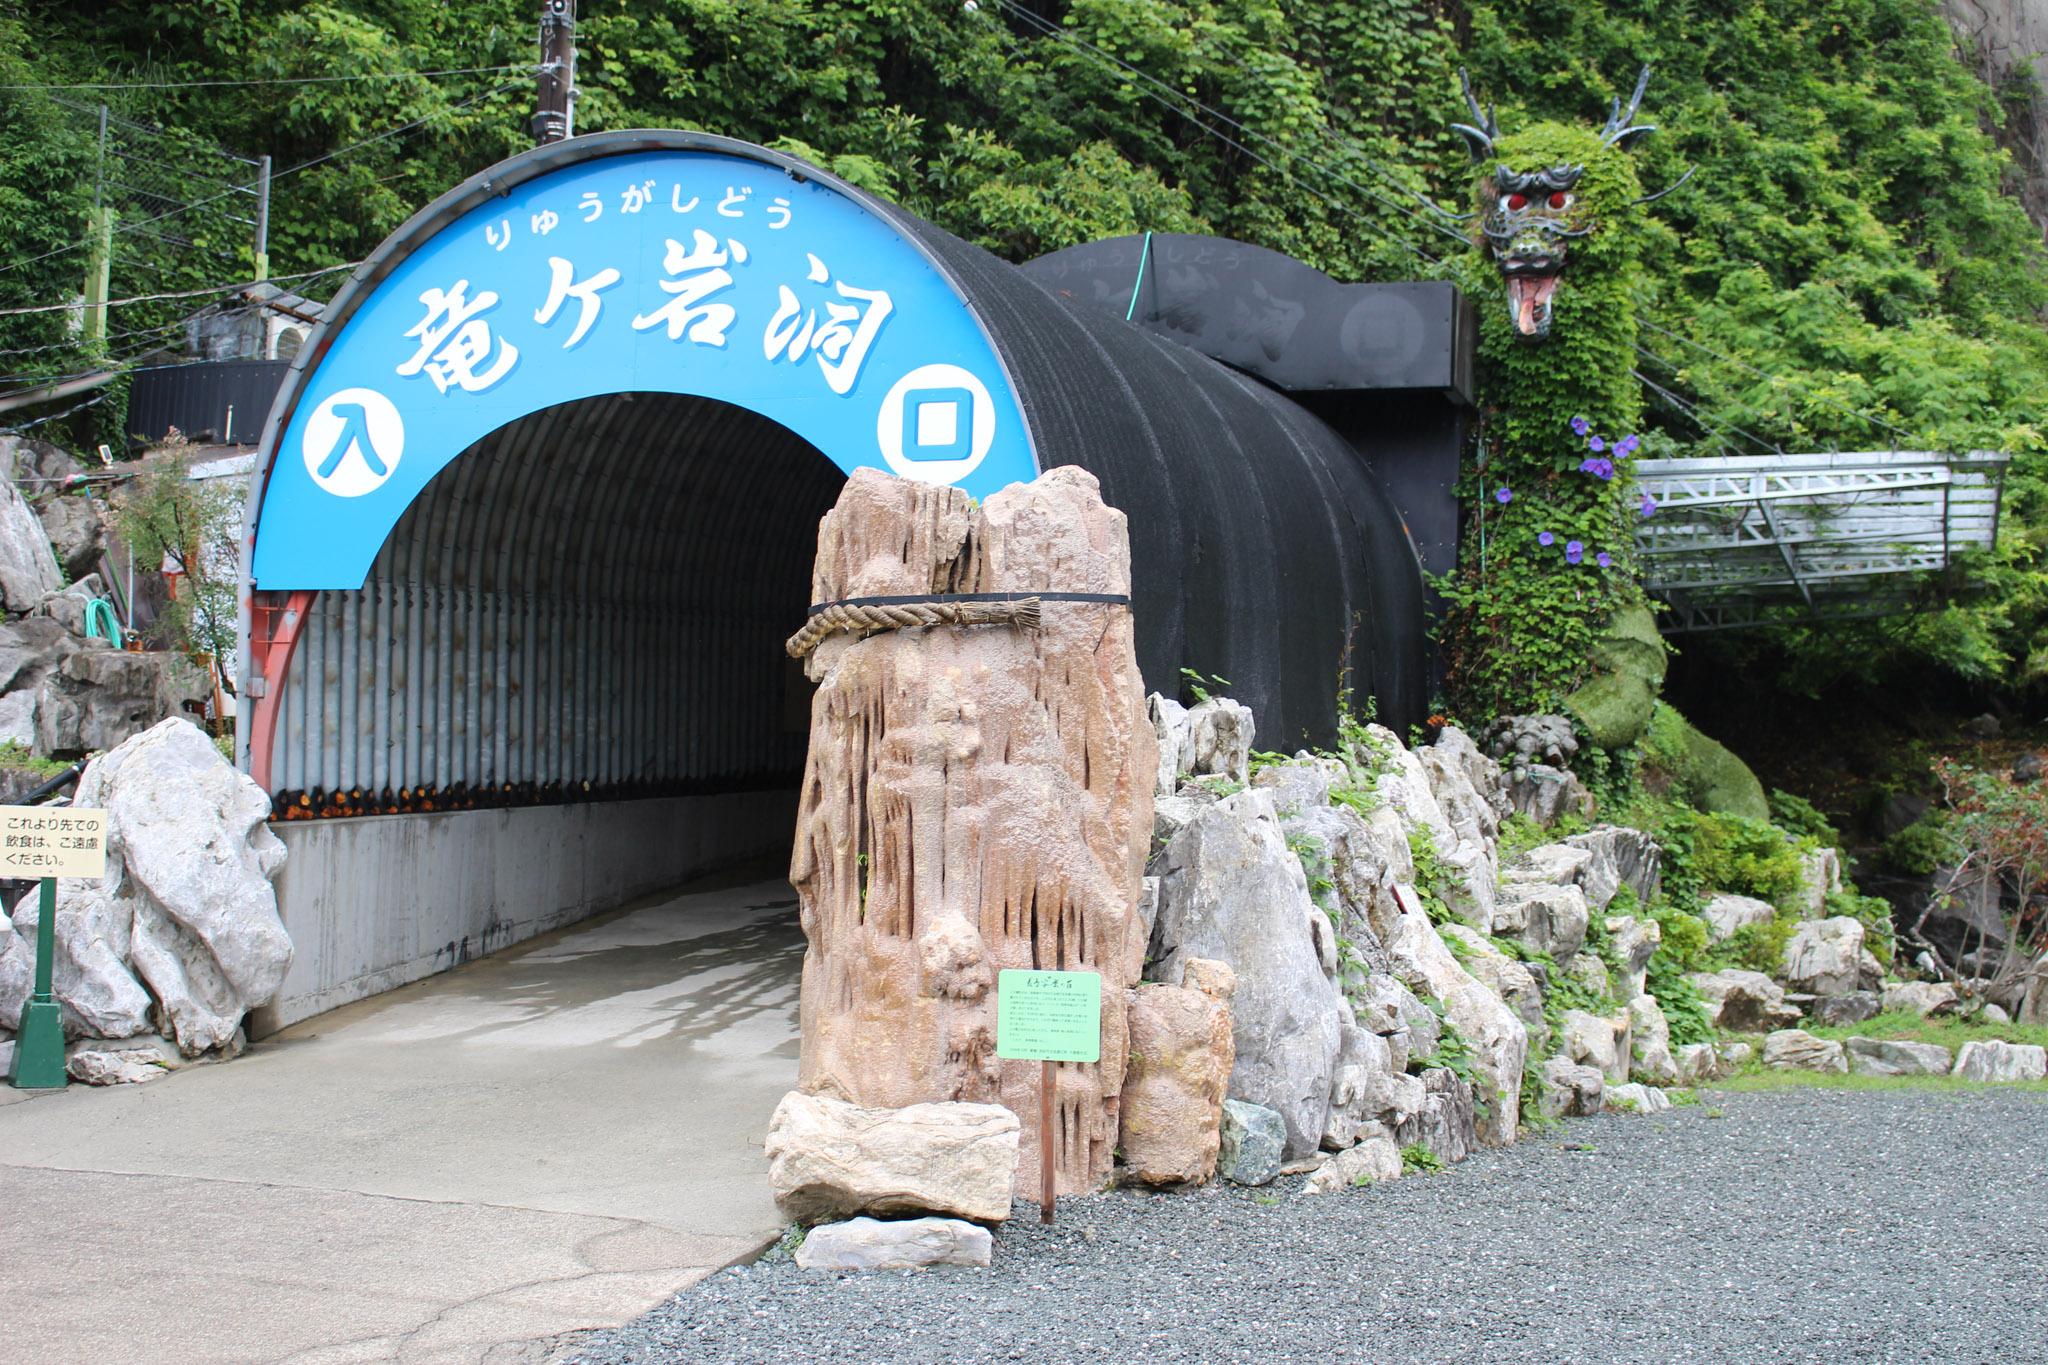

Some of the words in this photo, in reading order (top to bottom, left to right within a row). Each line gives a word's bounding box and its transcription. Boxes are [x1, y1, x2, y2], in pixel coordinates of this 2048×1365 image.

[485, 178, 793, 251] りゅうがしどう
[317, 402, 389, 479] 入
[7, 817, 99, 832] これより先での
[6, 835, 98, 850] 飲食は、ご遠慮
[6, 853, 64, 866] ください。
